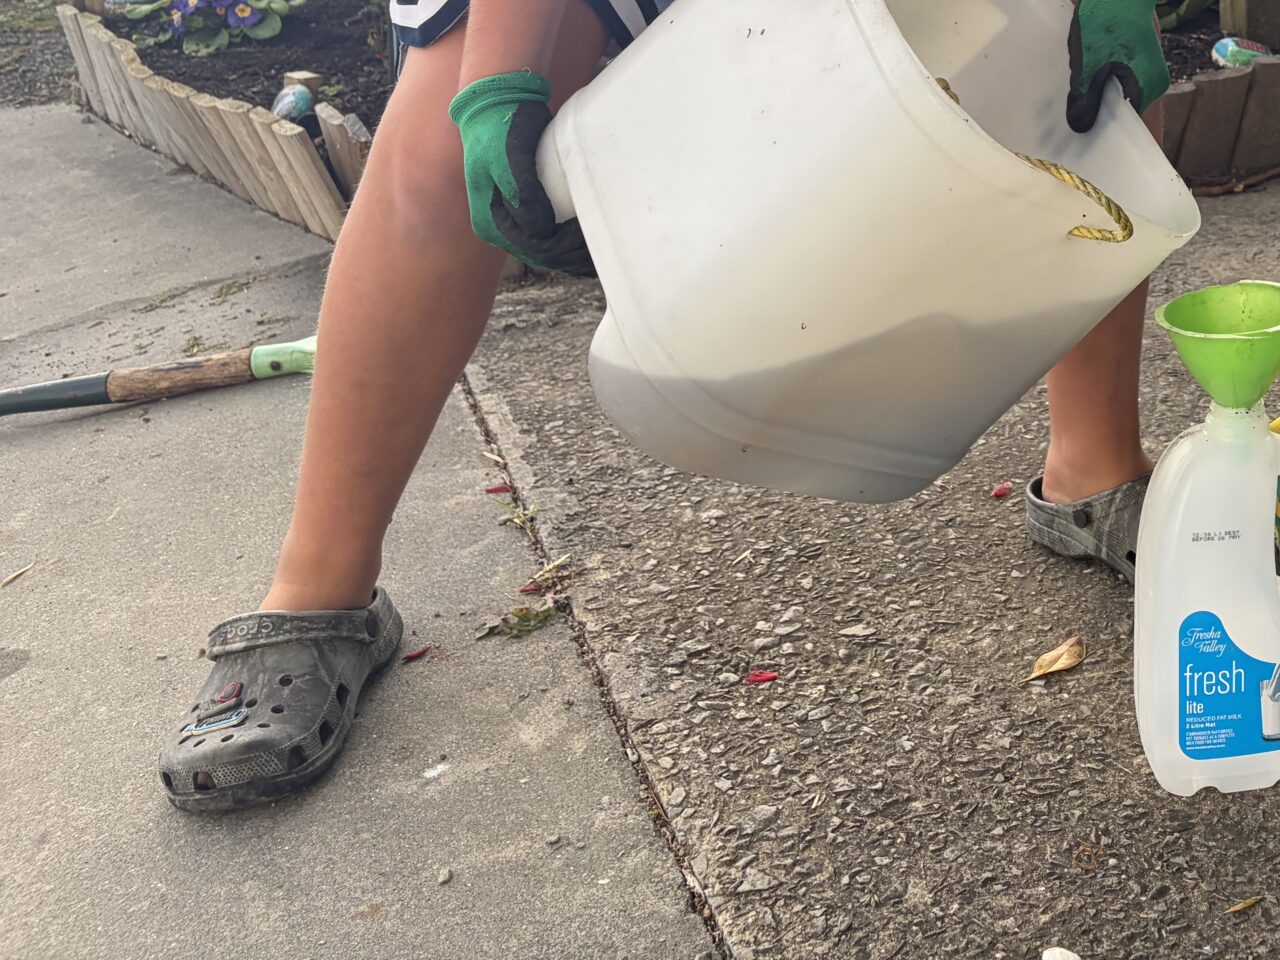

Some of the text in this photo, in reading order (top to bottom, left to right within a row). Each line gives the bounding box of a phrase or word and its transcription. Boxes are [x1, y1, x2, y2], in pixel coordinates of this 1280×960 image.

[1181, 626, 1222, 647] Fresha
[1194, 639, 1227, 658] Valley
[1183, 660, 1245, 696] fresh
[1186, 700, 1204, 714] lite
[1185, 715, 1216, 723] REDUCED
